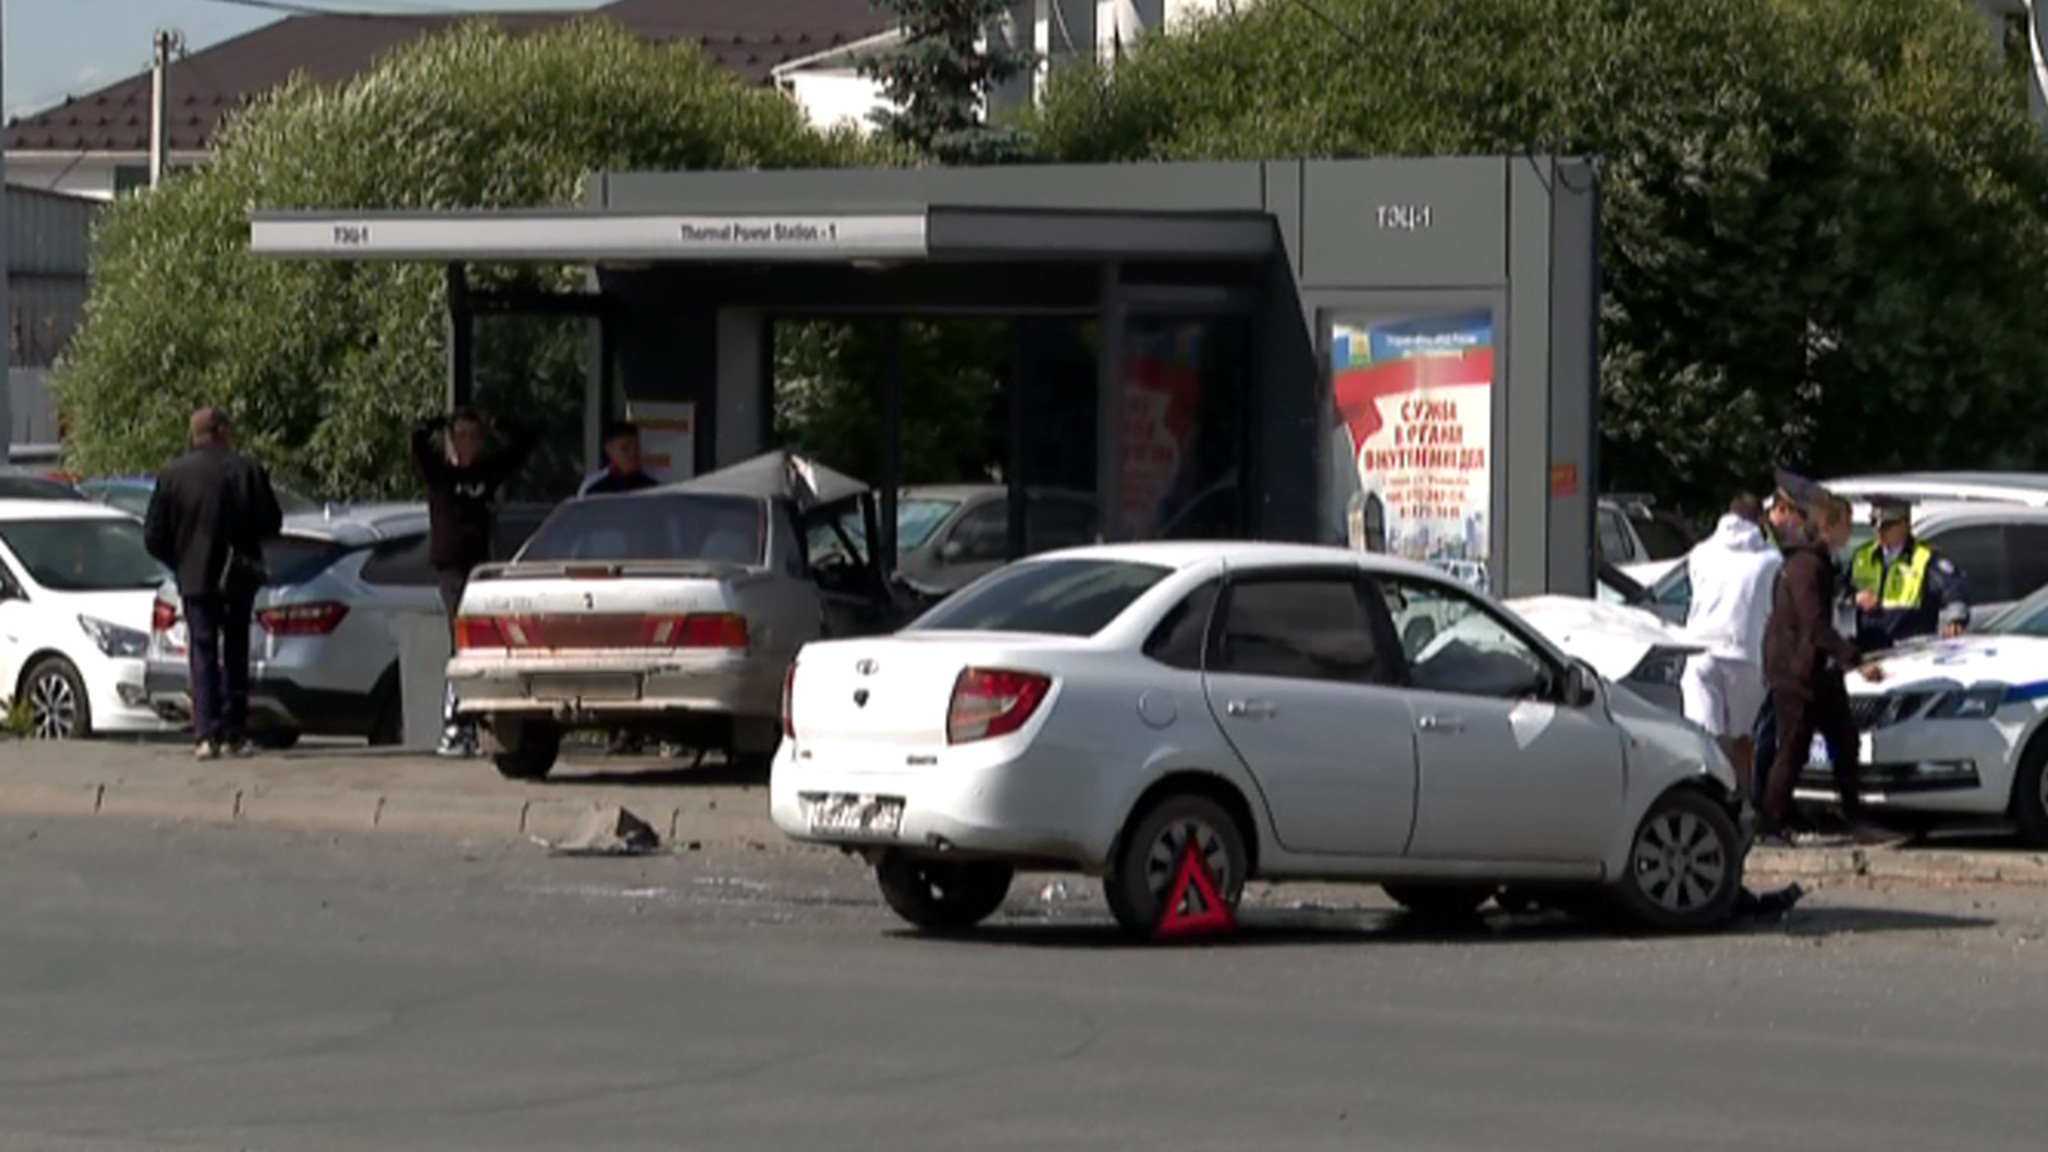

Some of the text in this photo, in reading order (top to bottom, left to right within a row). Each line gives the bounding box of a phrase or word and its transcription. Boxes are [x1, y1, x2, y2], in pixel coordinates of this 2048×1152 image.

[1378, 204, 1430, 231] ТЭЦ-1
[681, 223, 731, 241] Thermal
[733, 223, 771, 241] Power
[773, 223, 818, 241] Station
